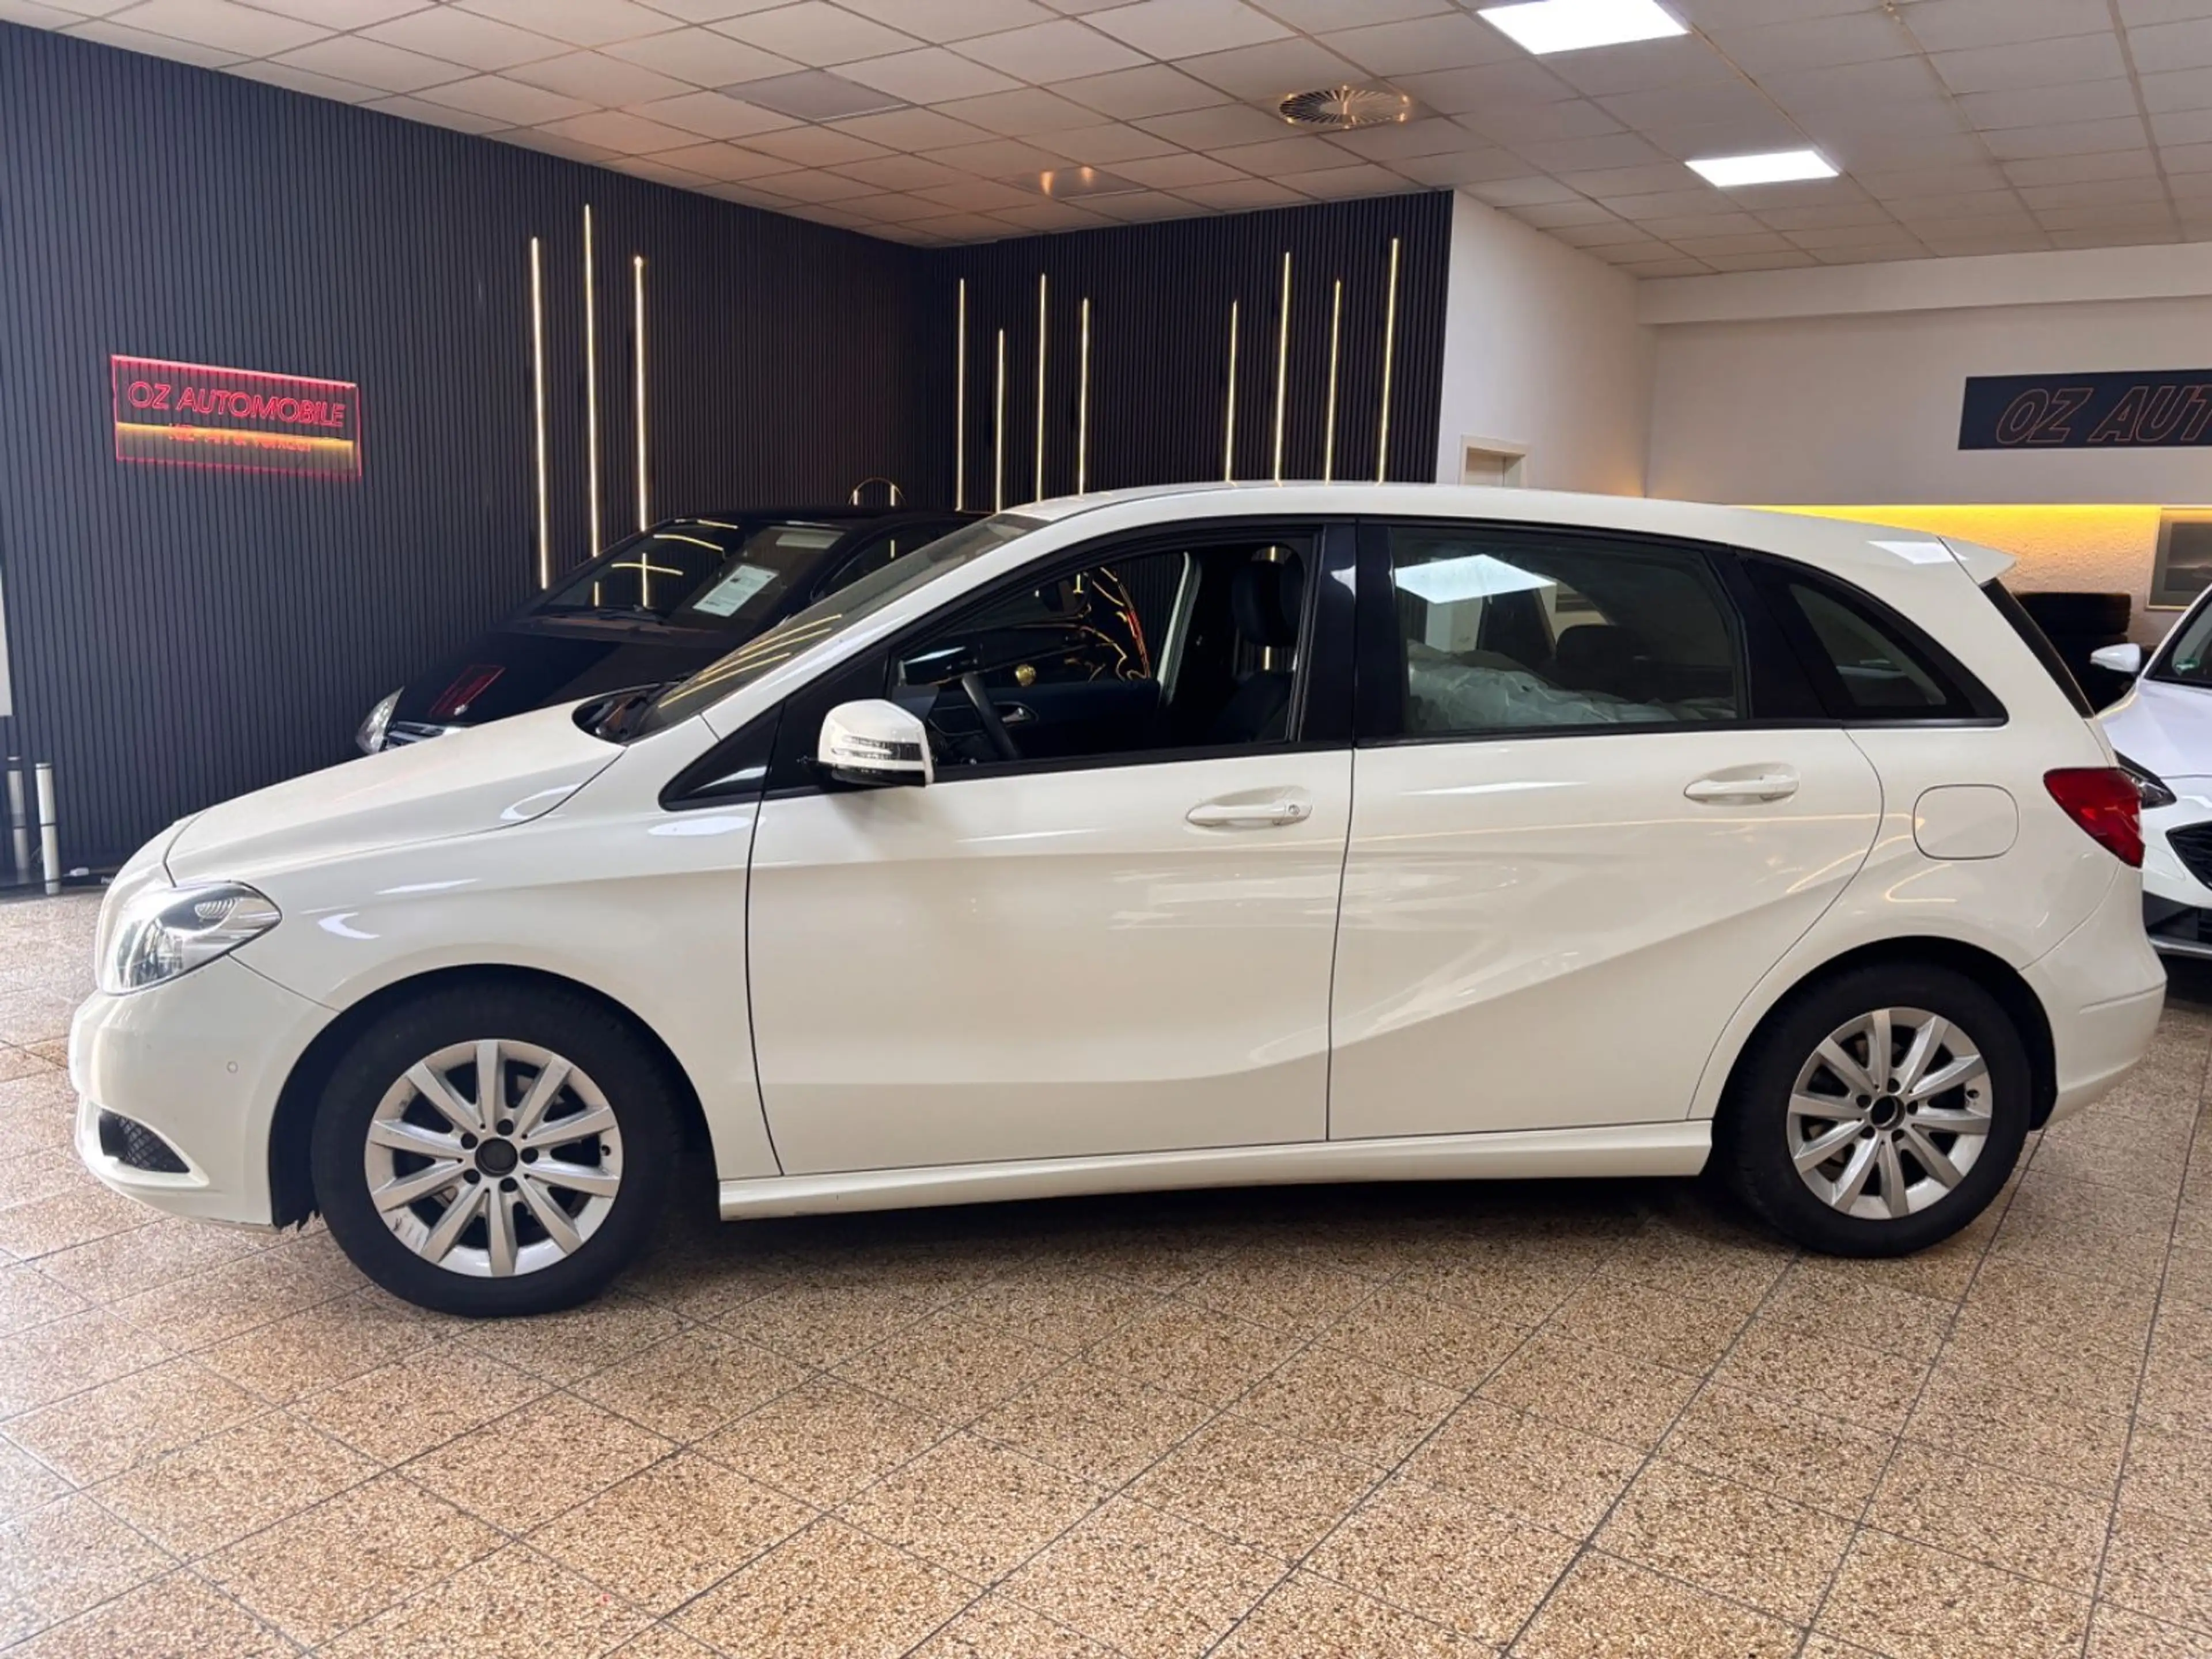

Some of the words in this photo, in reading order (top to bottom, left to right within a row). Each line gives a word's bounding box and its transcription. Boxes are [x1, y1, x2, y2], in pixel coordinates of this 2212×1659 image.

[128, 381, 171, 410] OZ
[176, 387, 345, 427] AUTOMOBILE
[1996, 388, 2094, 444] OZ
